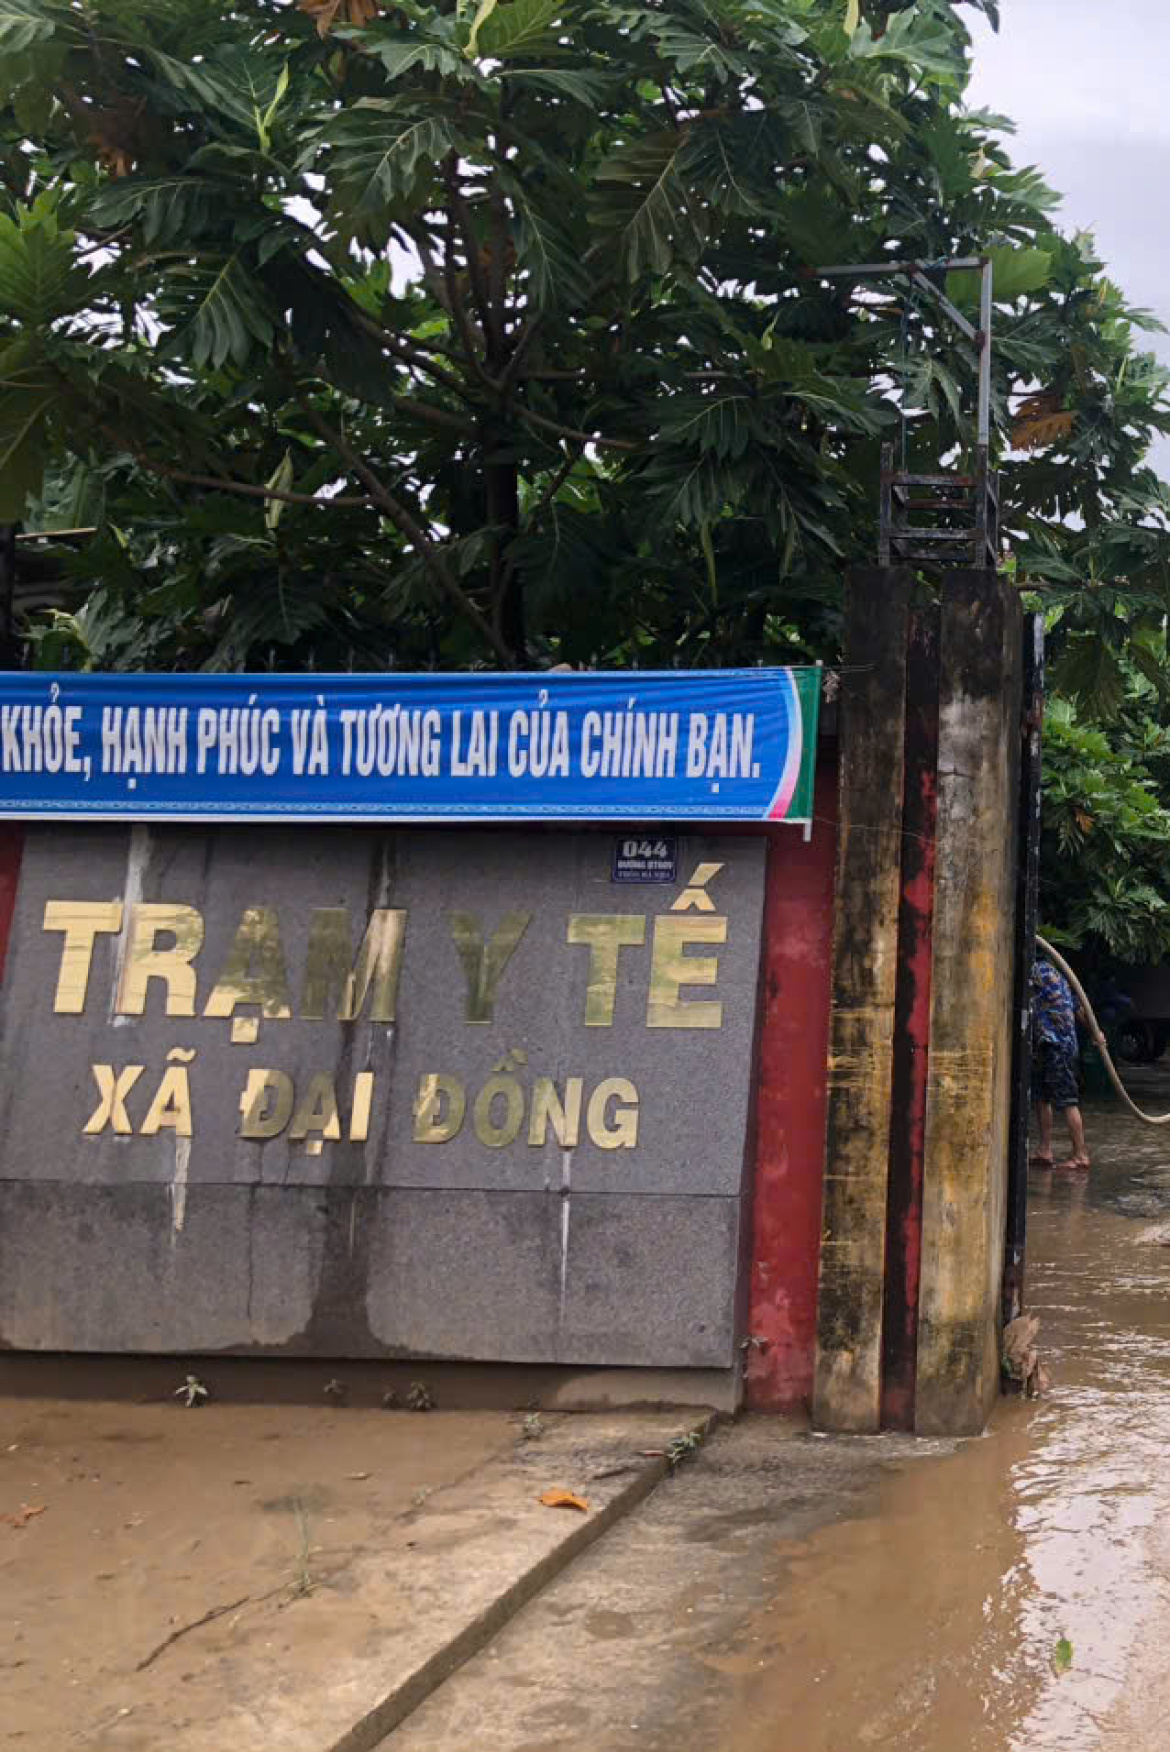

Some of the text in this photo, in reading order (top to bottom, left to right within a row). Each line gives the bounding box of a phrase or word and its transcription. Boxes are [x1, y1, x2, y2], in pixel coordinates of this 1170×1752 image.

[1, 682, 761, 794] KHỎE, HẠNH PHÚC VÀ TƯƠNG LAI CỦA CHÍNH BẠN.
[622, 841, 668, 858] 044
[43, 863, 729, 1044] TRẠM Y TẾ
[81, 1047, 640, 1156] XÃ ĐẠI ĐỒNG
